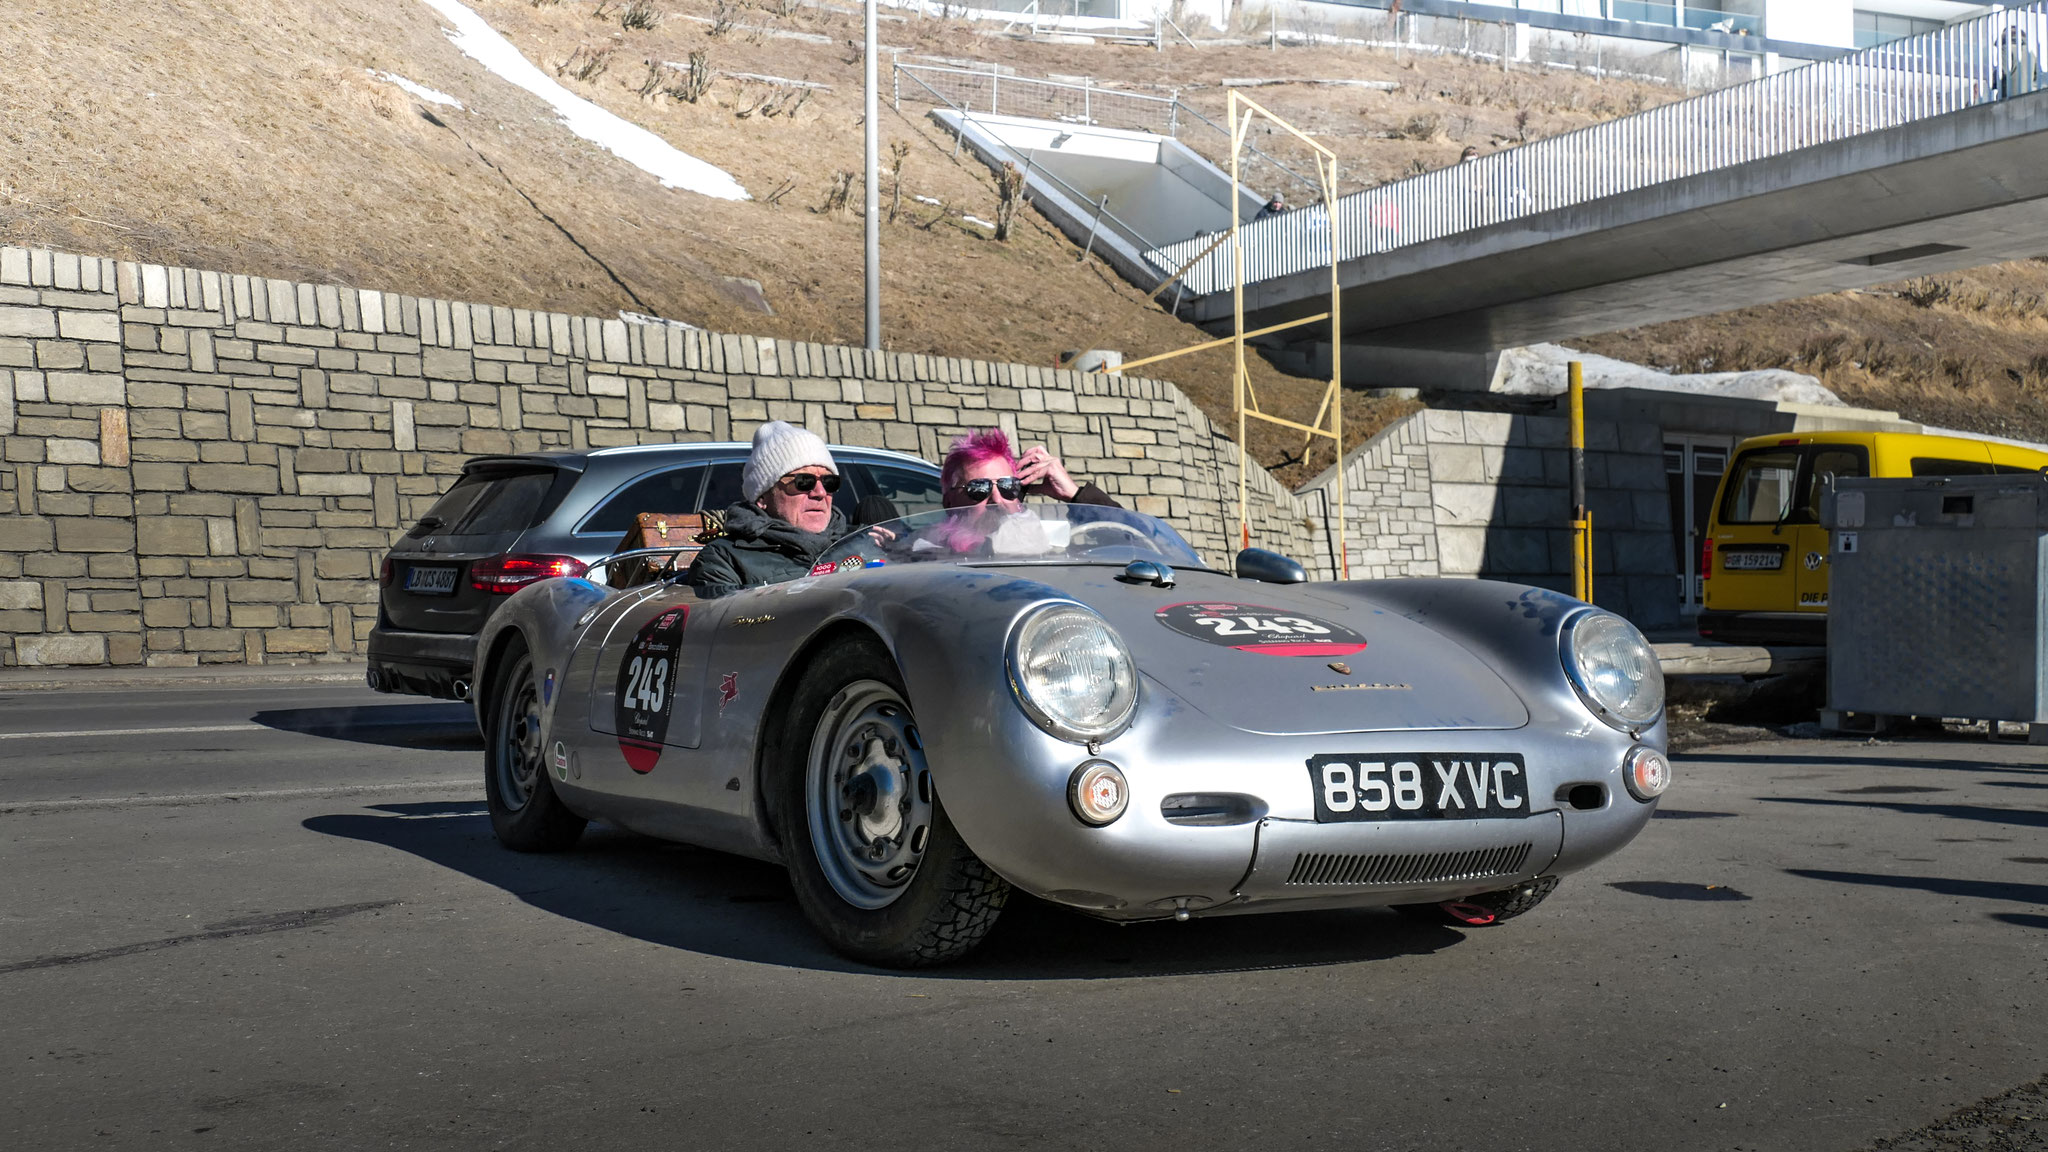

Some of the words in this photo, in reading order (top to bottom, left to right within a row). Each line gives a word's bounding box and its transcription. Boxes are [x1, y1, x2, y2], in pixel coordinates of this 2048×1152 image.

[1744, 553, 1775, 566] 159214
[1801, 592, 1819, 603] DIE
[1195, 616, 1331, 636] 243
[623, 655, 669, 713] 243
[1322, 761, 1424, 812] 858
[1432, 761, 1523, 810] XVC
